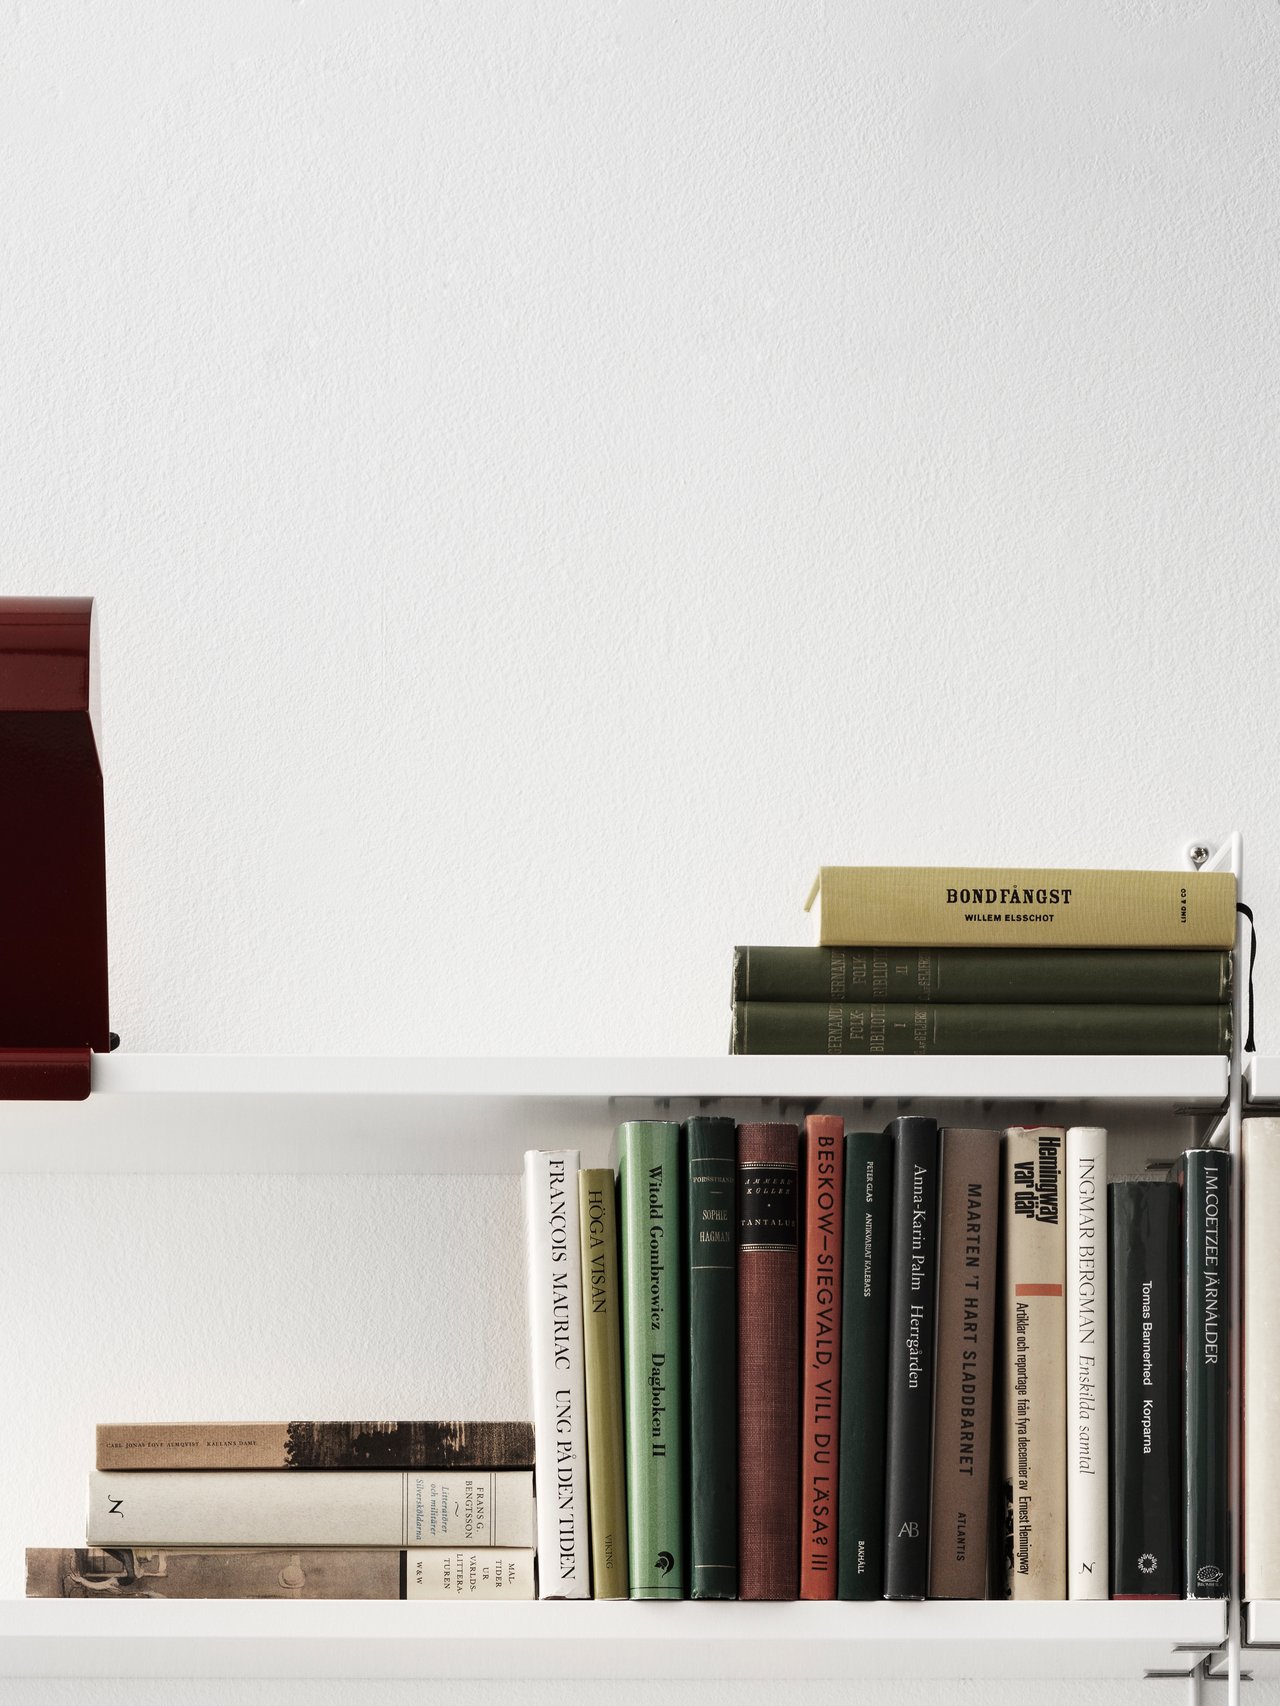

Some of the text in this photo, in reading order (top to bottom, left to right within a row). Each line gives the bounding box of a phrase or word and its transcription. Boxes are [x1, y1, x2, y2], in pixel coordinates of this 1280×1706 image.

[946, 884, 1072, 905] BONDFÅNGST
[964, 913, 1055, 923] WILLEM ELSSCHOT
[1013, 1161, 1037, 1219] var där
[1035, 1136, 1062, 1225] Hemingway
[587, 1190, 607, 1313] HÖGA VISAN
[864, 1212, 873, 1259] ANTIKVARIAT
[863, 1260, 872, 1297] KALEBASS
[905, 1164, 928, 1388] Anna-Karin Palm Herrgården
[647, 1165, 666, 1457] Witold Gombrowicz Dagboken II
[959, 1183, 983, 1476] MAARTEN HART SLADDBARNET
[1078, 1158, 1096, 1475] INGMAR BERGMAN Enskilda samtal
[548, 1160, 578, 1580] FRANÇOIS MAURIAC UNG PÅ DEN TIDEN
[1140, 1280, 1154, 1454] Tomas Bannerhed Korparna
[1014, 1302, 1032, 1575] Artiklar och reportage från fyra decennier av Ernest Hemingway
[811, 1379, 832, 1571] VILL DU LÄSA? III
[415, 1479, 425, 1540] Silversköldarna
[429, 1483, 441, 1536] och militärer
[440, 1486, 450, 1533] Litteratörer
[464, 1480, 473, 1539] BENGTSSON
[476, 1487, 485, 1533] FRANS G.
[956, 1512, 967, 1562] ATLANTIS
[443, 1559, 451, 1589] TUREN
[456, 1553, 464, 1594] LITTERA-
[469, 1555, 477, 1592] VÄRLDS-
[482, 1567, 490, 1581] UR
[495, 1561, 503, 1588] TIDER
